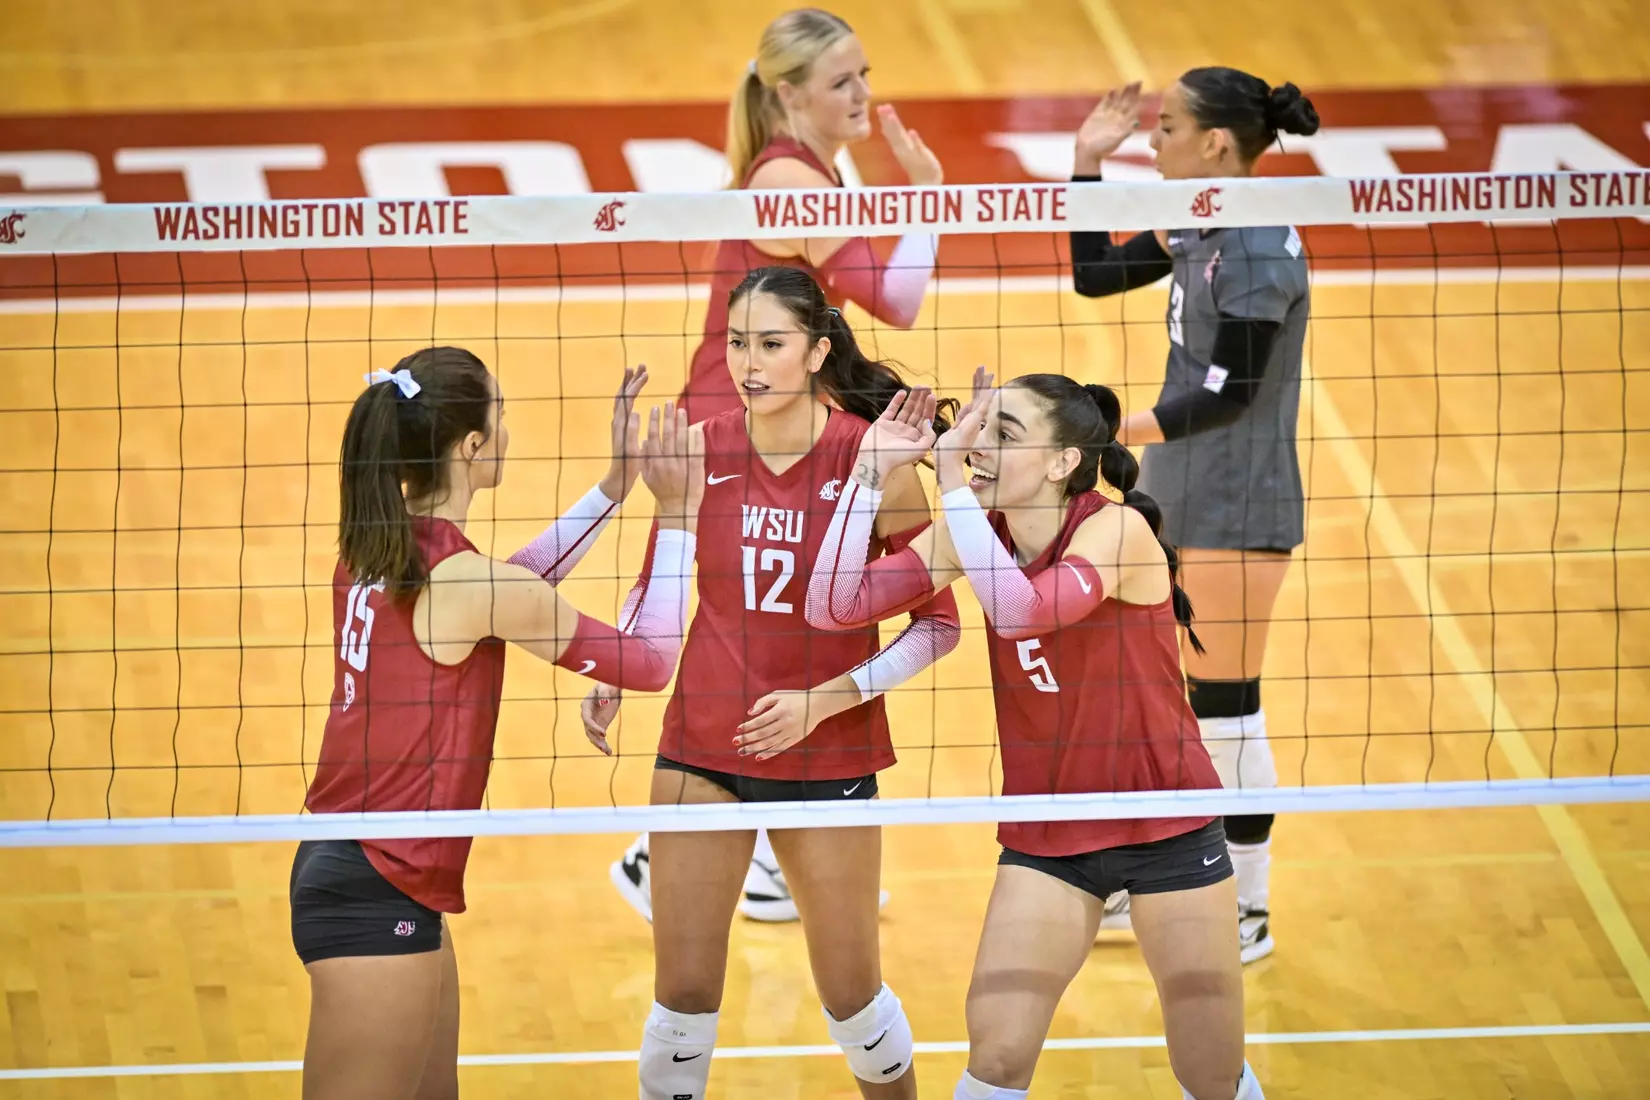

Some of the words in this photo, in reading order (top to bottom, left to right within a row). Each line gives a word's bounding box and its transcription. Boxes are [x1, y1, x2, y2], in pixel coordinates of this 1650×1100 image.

[753, 190, 962, 228] WASHINGTON
[976, 187, 1067, 222] STATE
[1348, 175, 1556, 213] WASHINGTON
[153, 202, 364, 240] WASHINGTON
[377, 200, 469, 236] STATE
[741, 504, 805, 543] WSU
[741, 545, 796, 614] 12
[340, 573, 386, 673] 15
[1015, 638, 1060, 693] 5
